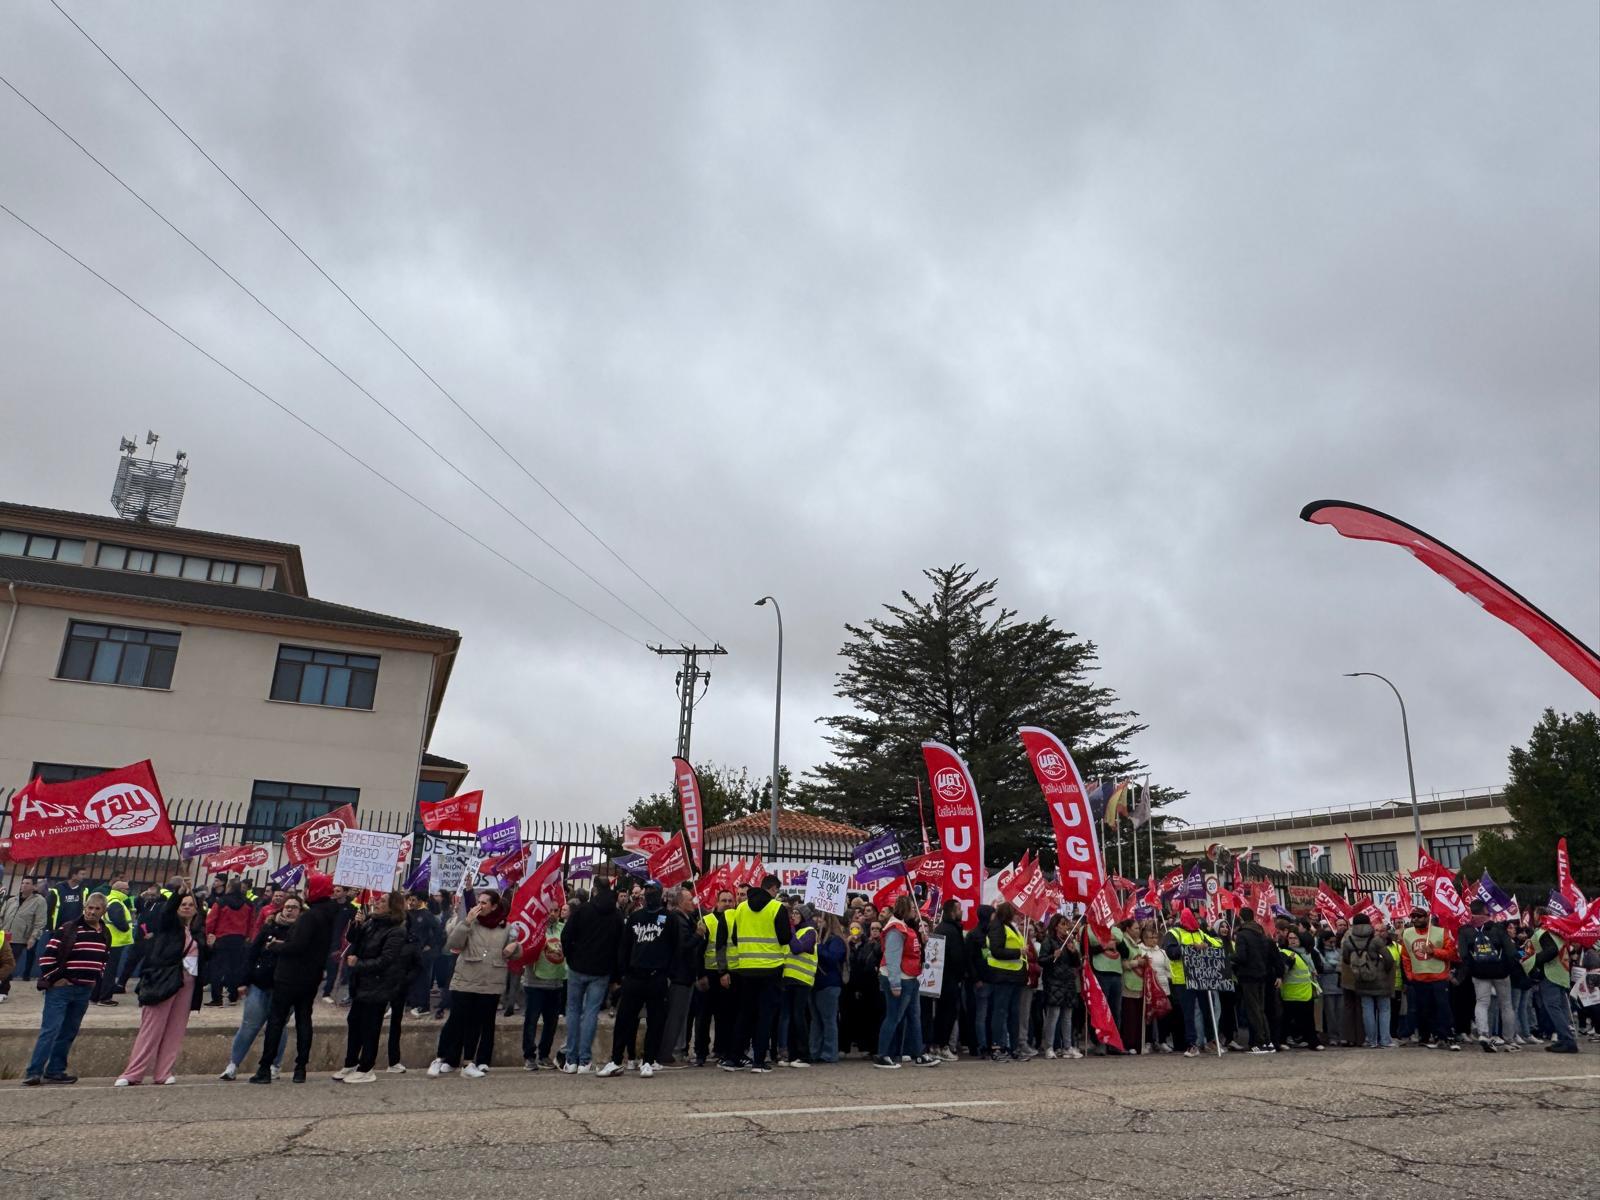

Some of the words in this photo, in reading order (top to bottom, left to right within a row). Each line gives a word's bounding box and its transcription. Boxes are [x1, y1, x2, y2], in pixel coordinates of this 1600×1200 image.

[1039, 754, 1062, 768] UGT
[938, 774, 961, 788] UGT
[1053, 802, 1093, 896] UGT
[811, 867, 820, 879] EL
[821, 869, 847, 885] TRABAJO
[945, 827, 975, 922] UGT
[1208, 882, 1216, 891] 20
